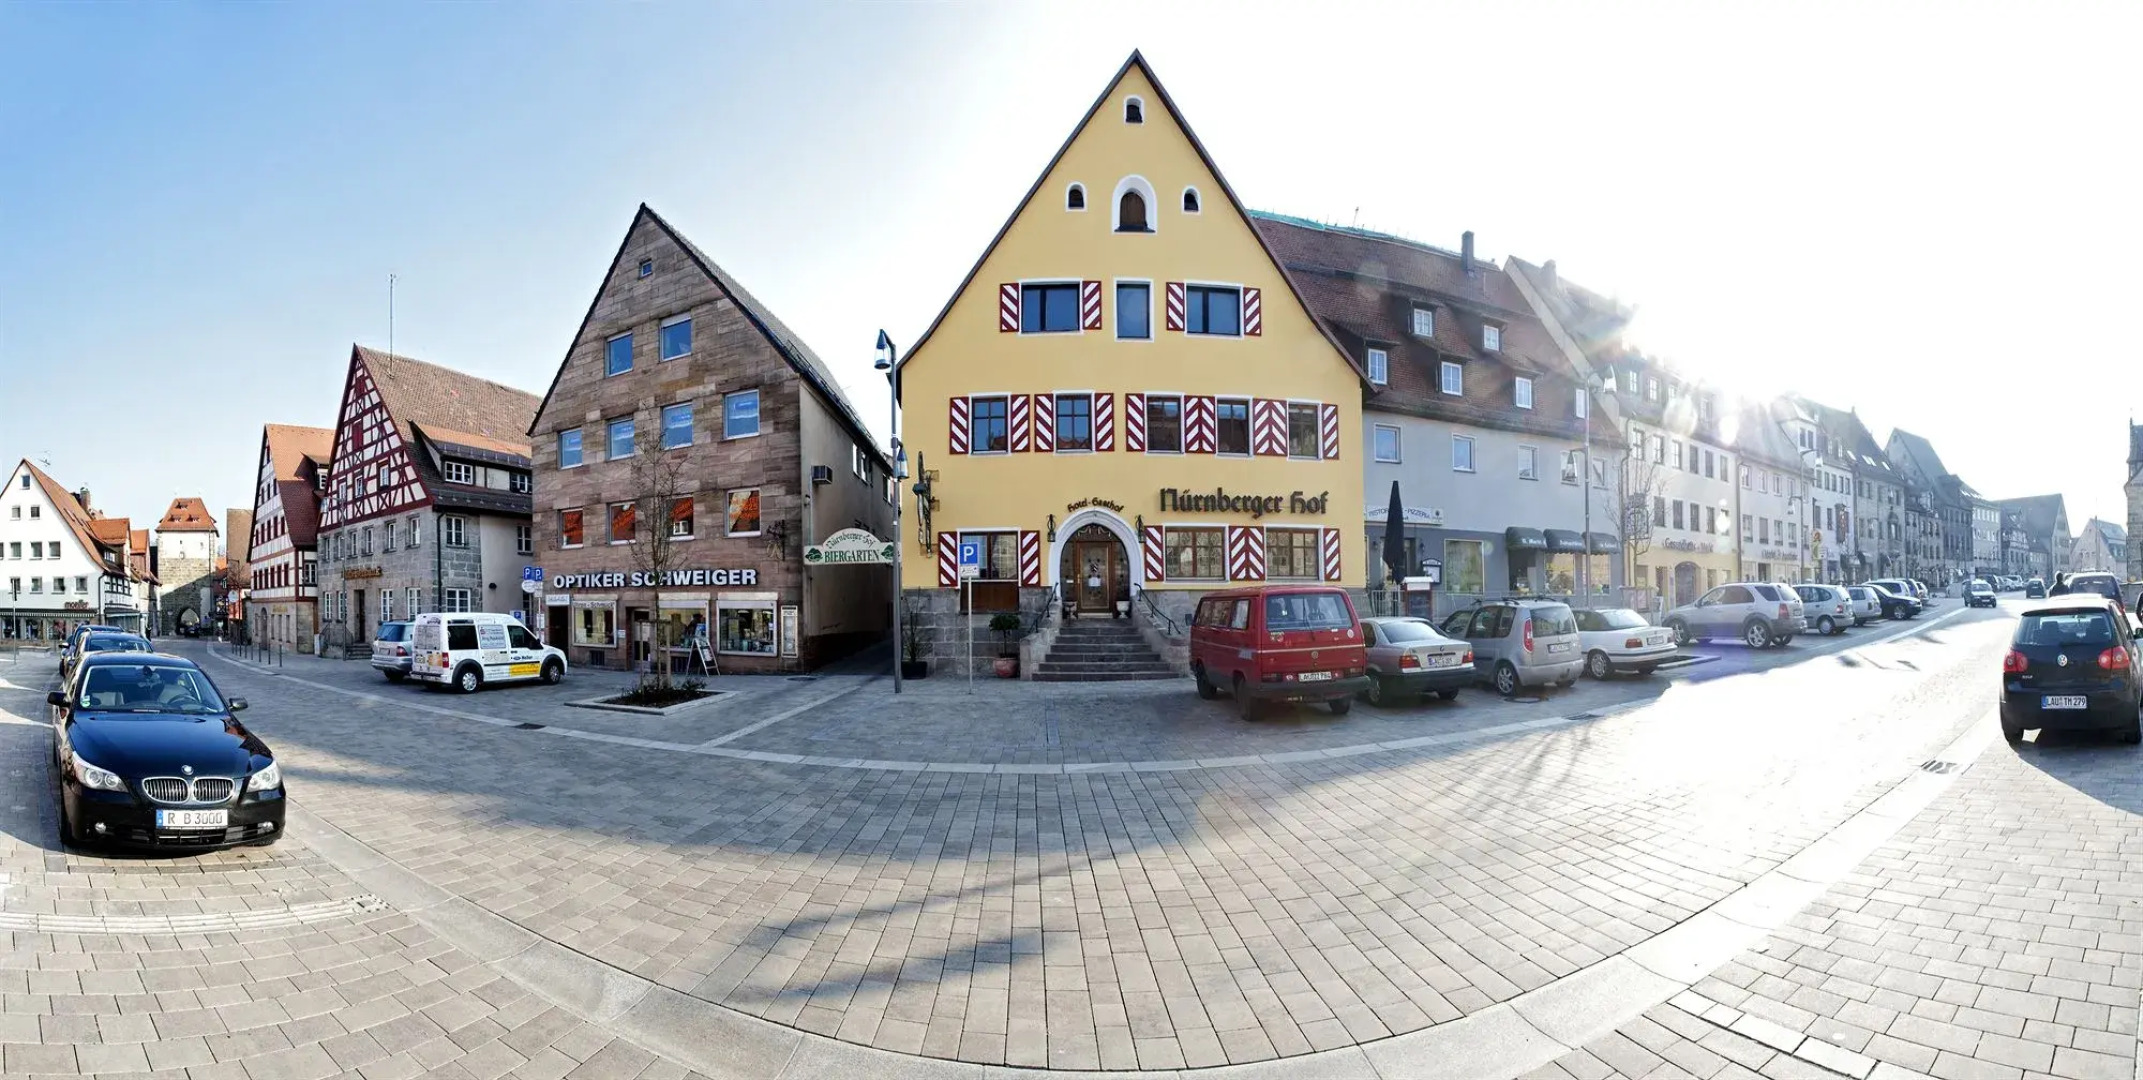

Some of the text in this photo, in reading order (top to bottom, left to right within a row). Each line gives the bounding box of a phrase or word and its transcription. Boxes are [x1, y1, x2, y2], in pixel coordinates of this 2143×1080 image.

[1067, 497, 1088, 512] Hotel
[1091, 496, 1124, 512] Gasthof
[1159, 486, 1329, 520] Nürnberger Hof
[824, 549, 880, 563] BIERGARTEN
[963, 545, 975, 563] P
[553, 572, 625, 589] OPTIKER
[630, 568, 757, 587] SCHWEIGER
[2047, 696, 2086, 706] LAU TM 279
[167, 812, 223, 825] R B 3000
